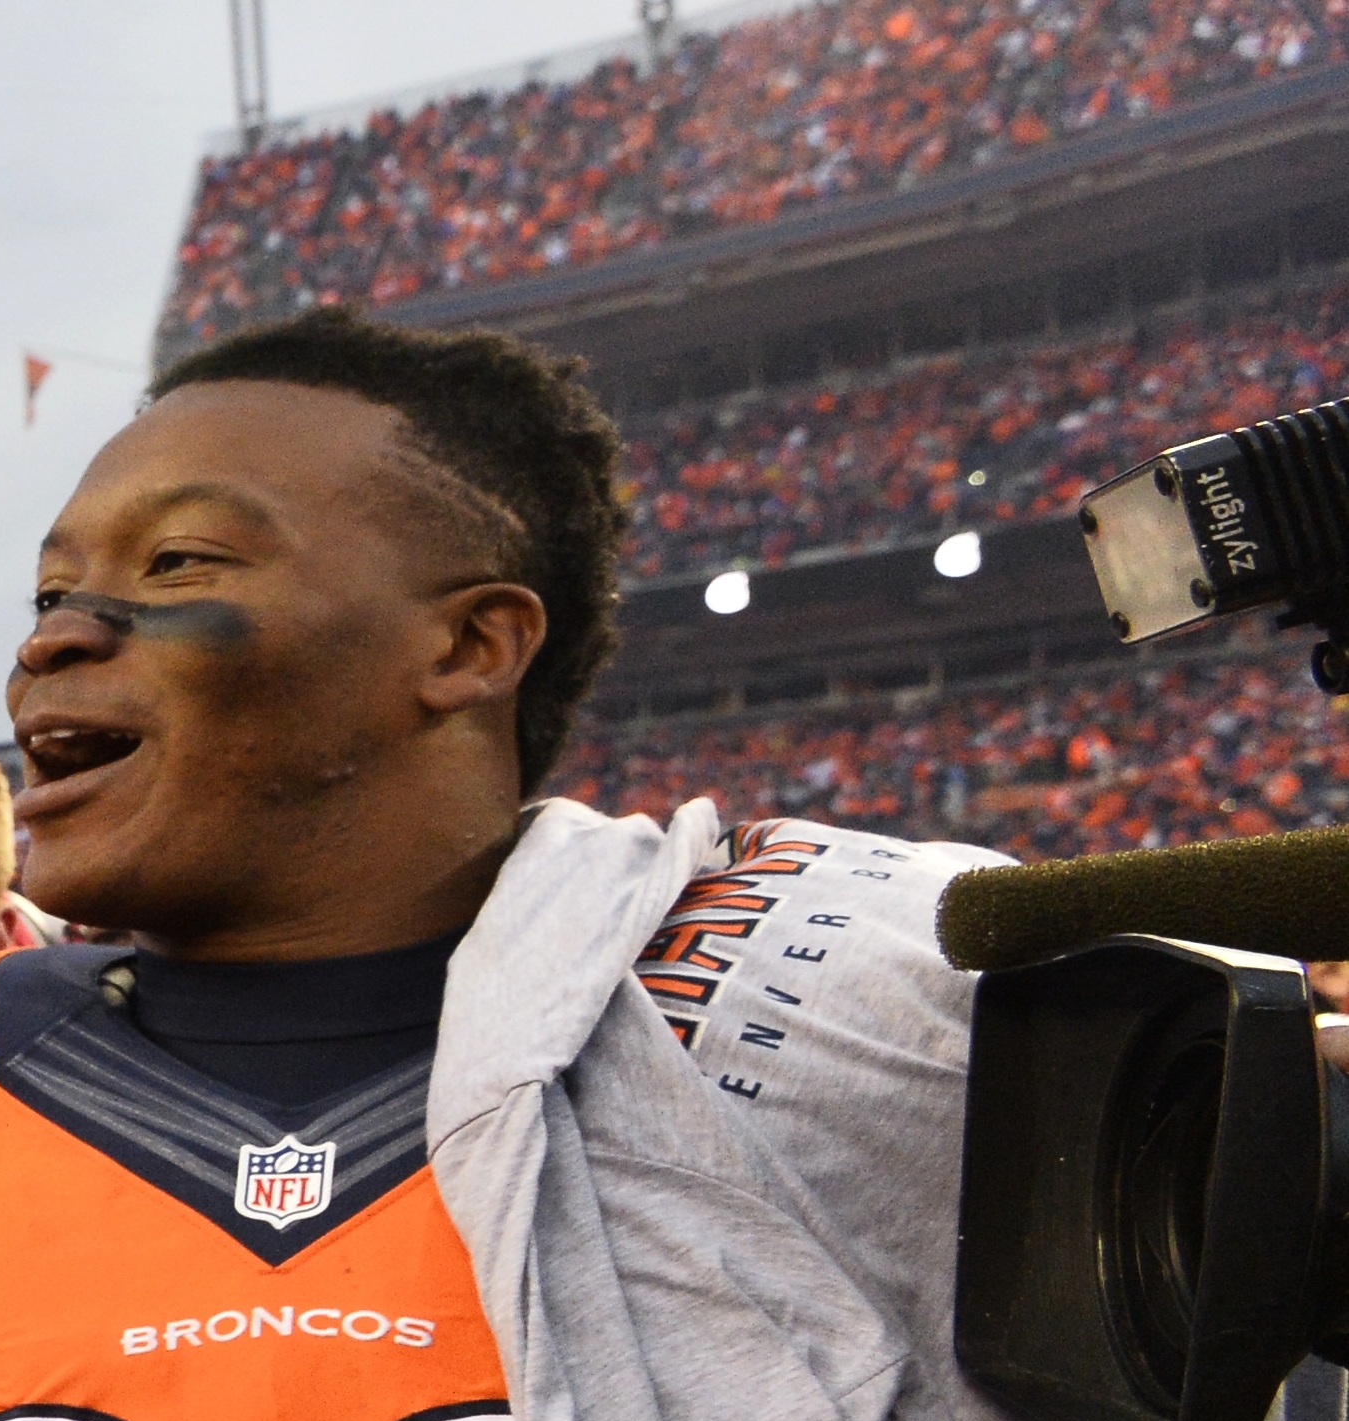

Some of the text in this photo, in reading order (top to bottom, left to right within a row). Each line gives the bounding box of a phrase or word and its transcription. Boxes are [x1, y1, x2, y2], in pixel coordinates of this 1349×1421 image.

[1196, 466, 1259, 576] zylight
[700, 912, 852, 1101] ENVER
[252, 1176, 317, 1212] NFL
[120, 1305, 436, 1356] BRONCOS
